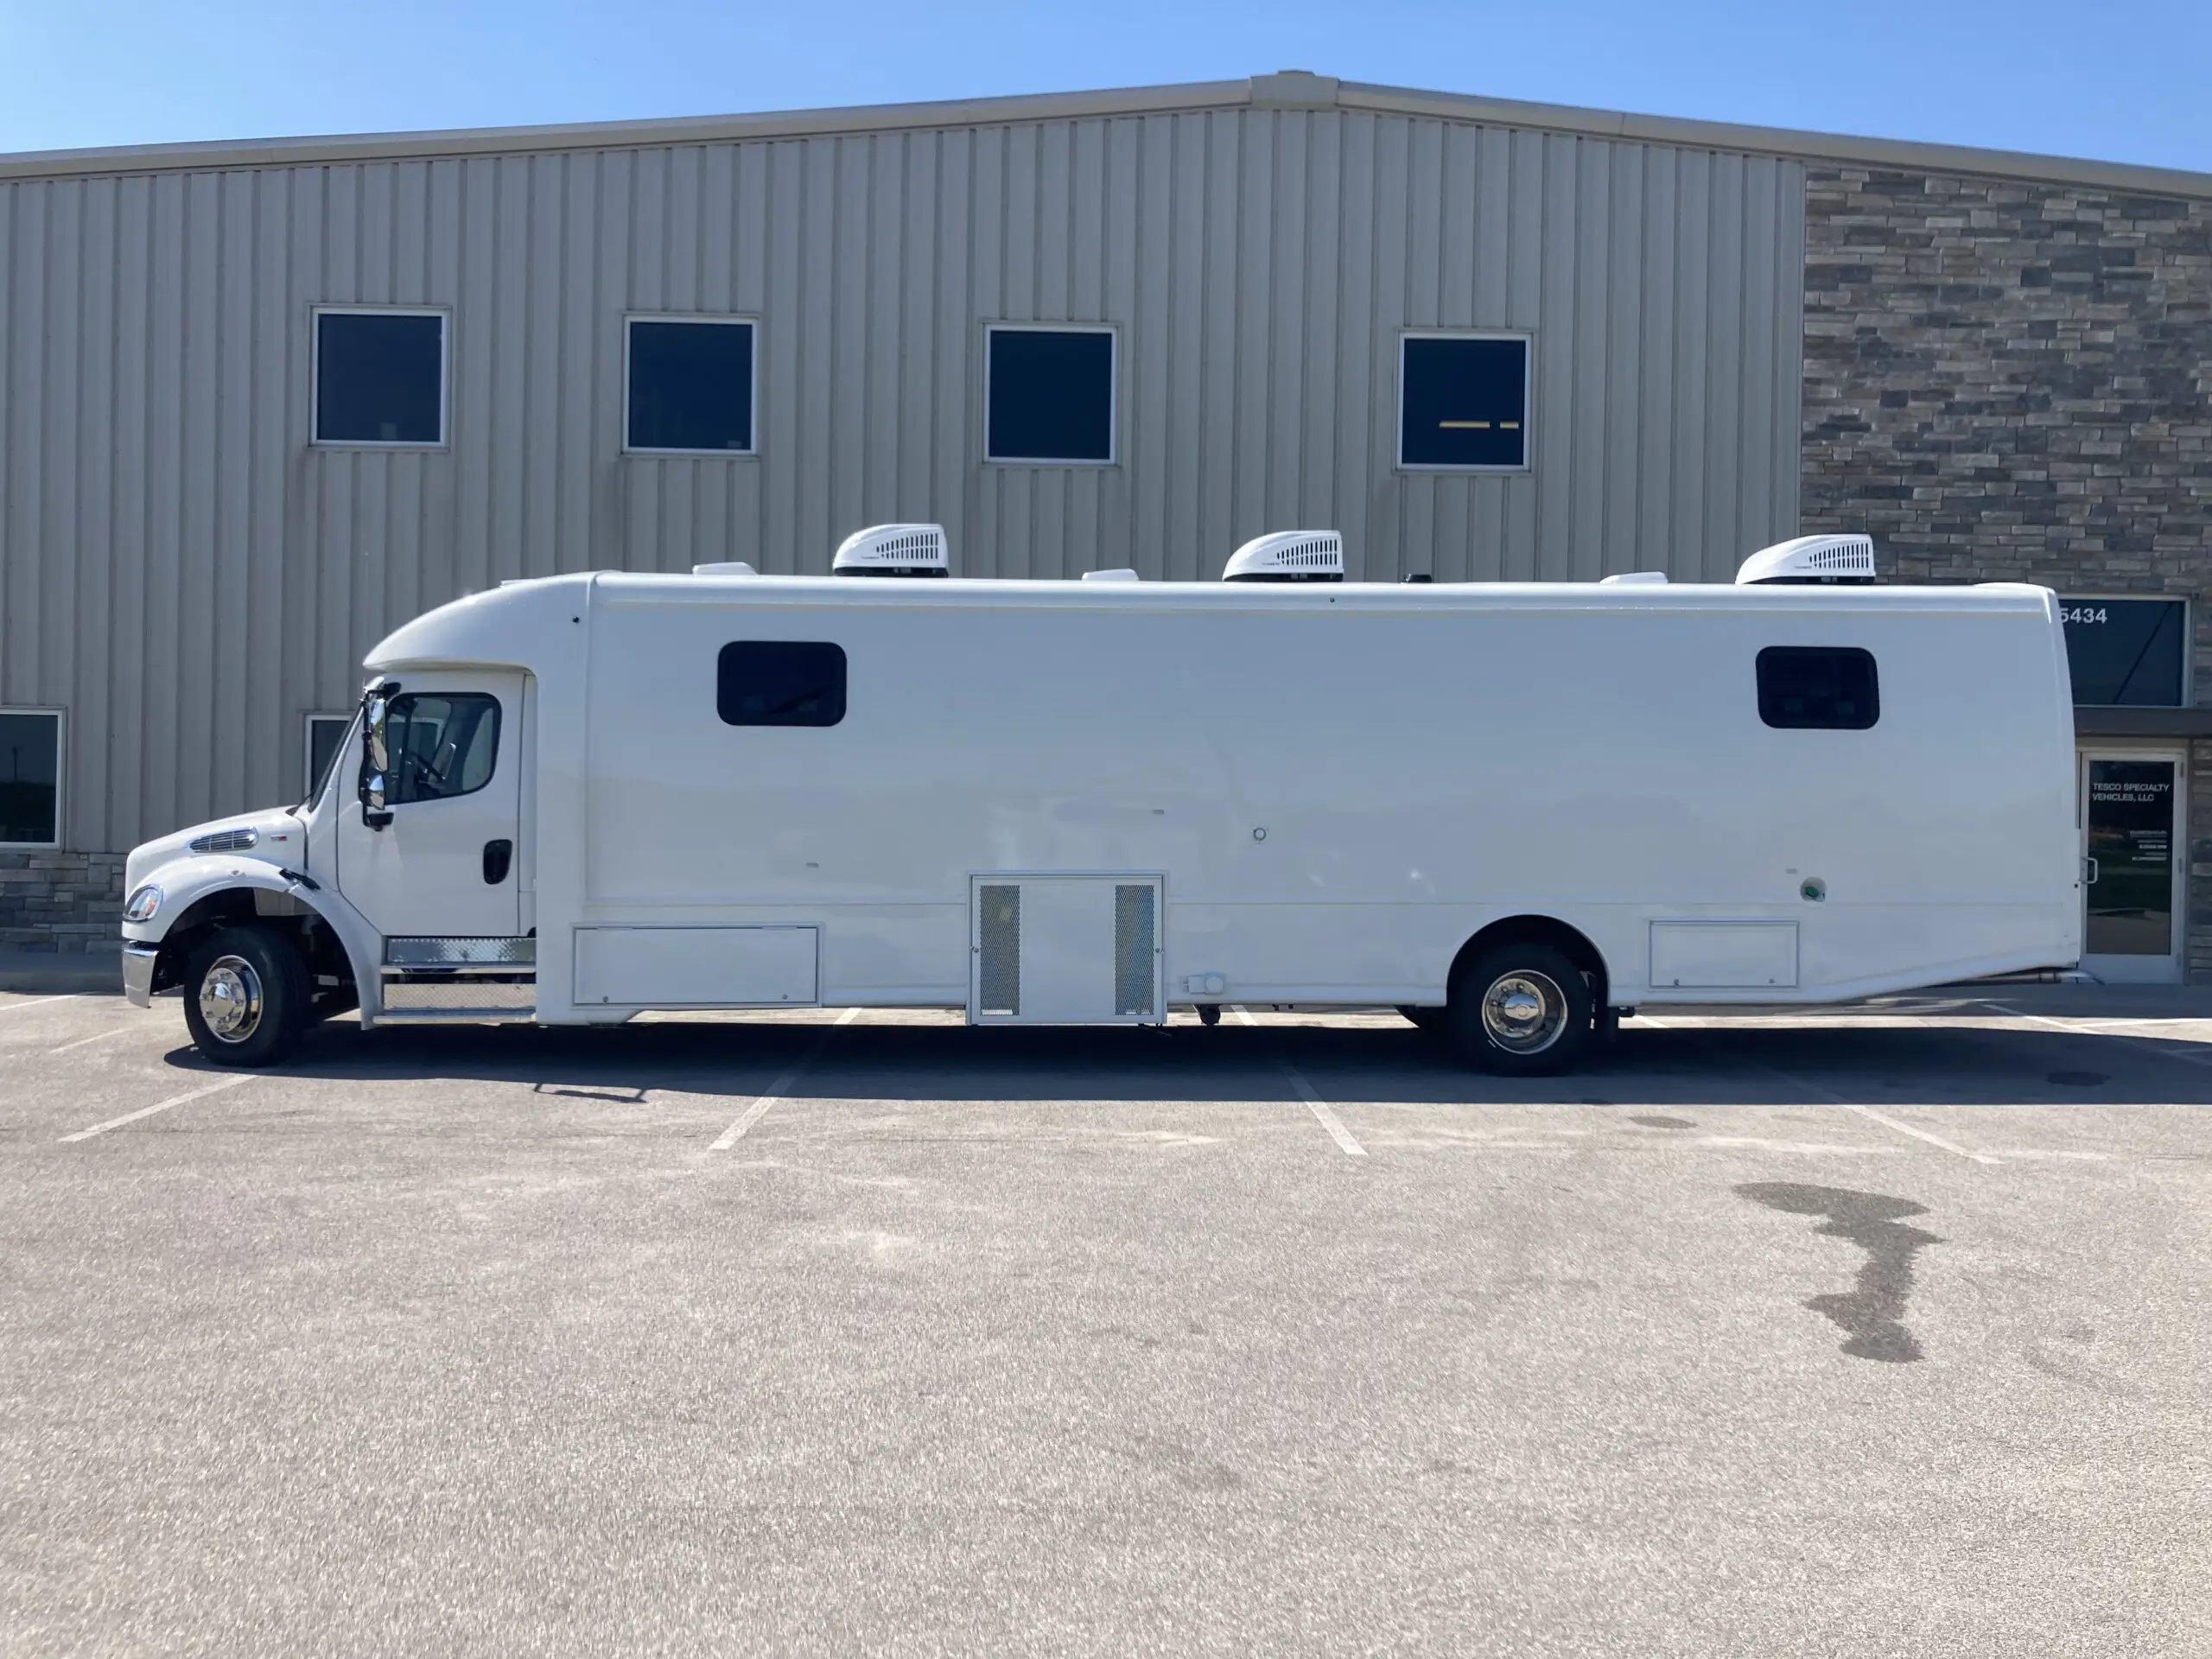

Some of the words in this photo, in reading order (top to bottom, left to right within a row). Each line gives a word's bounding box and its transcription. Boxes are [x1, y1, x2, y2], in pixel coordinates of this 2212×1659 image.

[2060, 607, 2107, 624] 5434
[2093, 783, 2121, 791] TESCO
[2123, 783, 2170, 791] SPECIALTY
[2092, 793, 2136, 802] VEHICLES,
[2138, 793, 2154, 802] LLC
